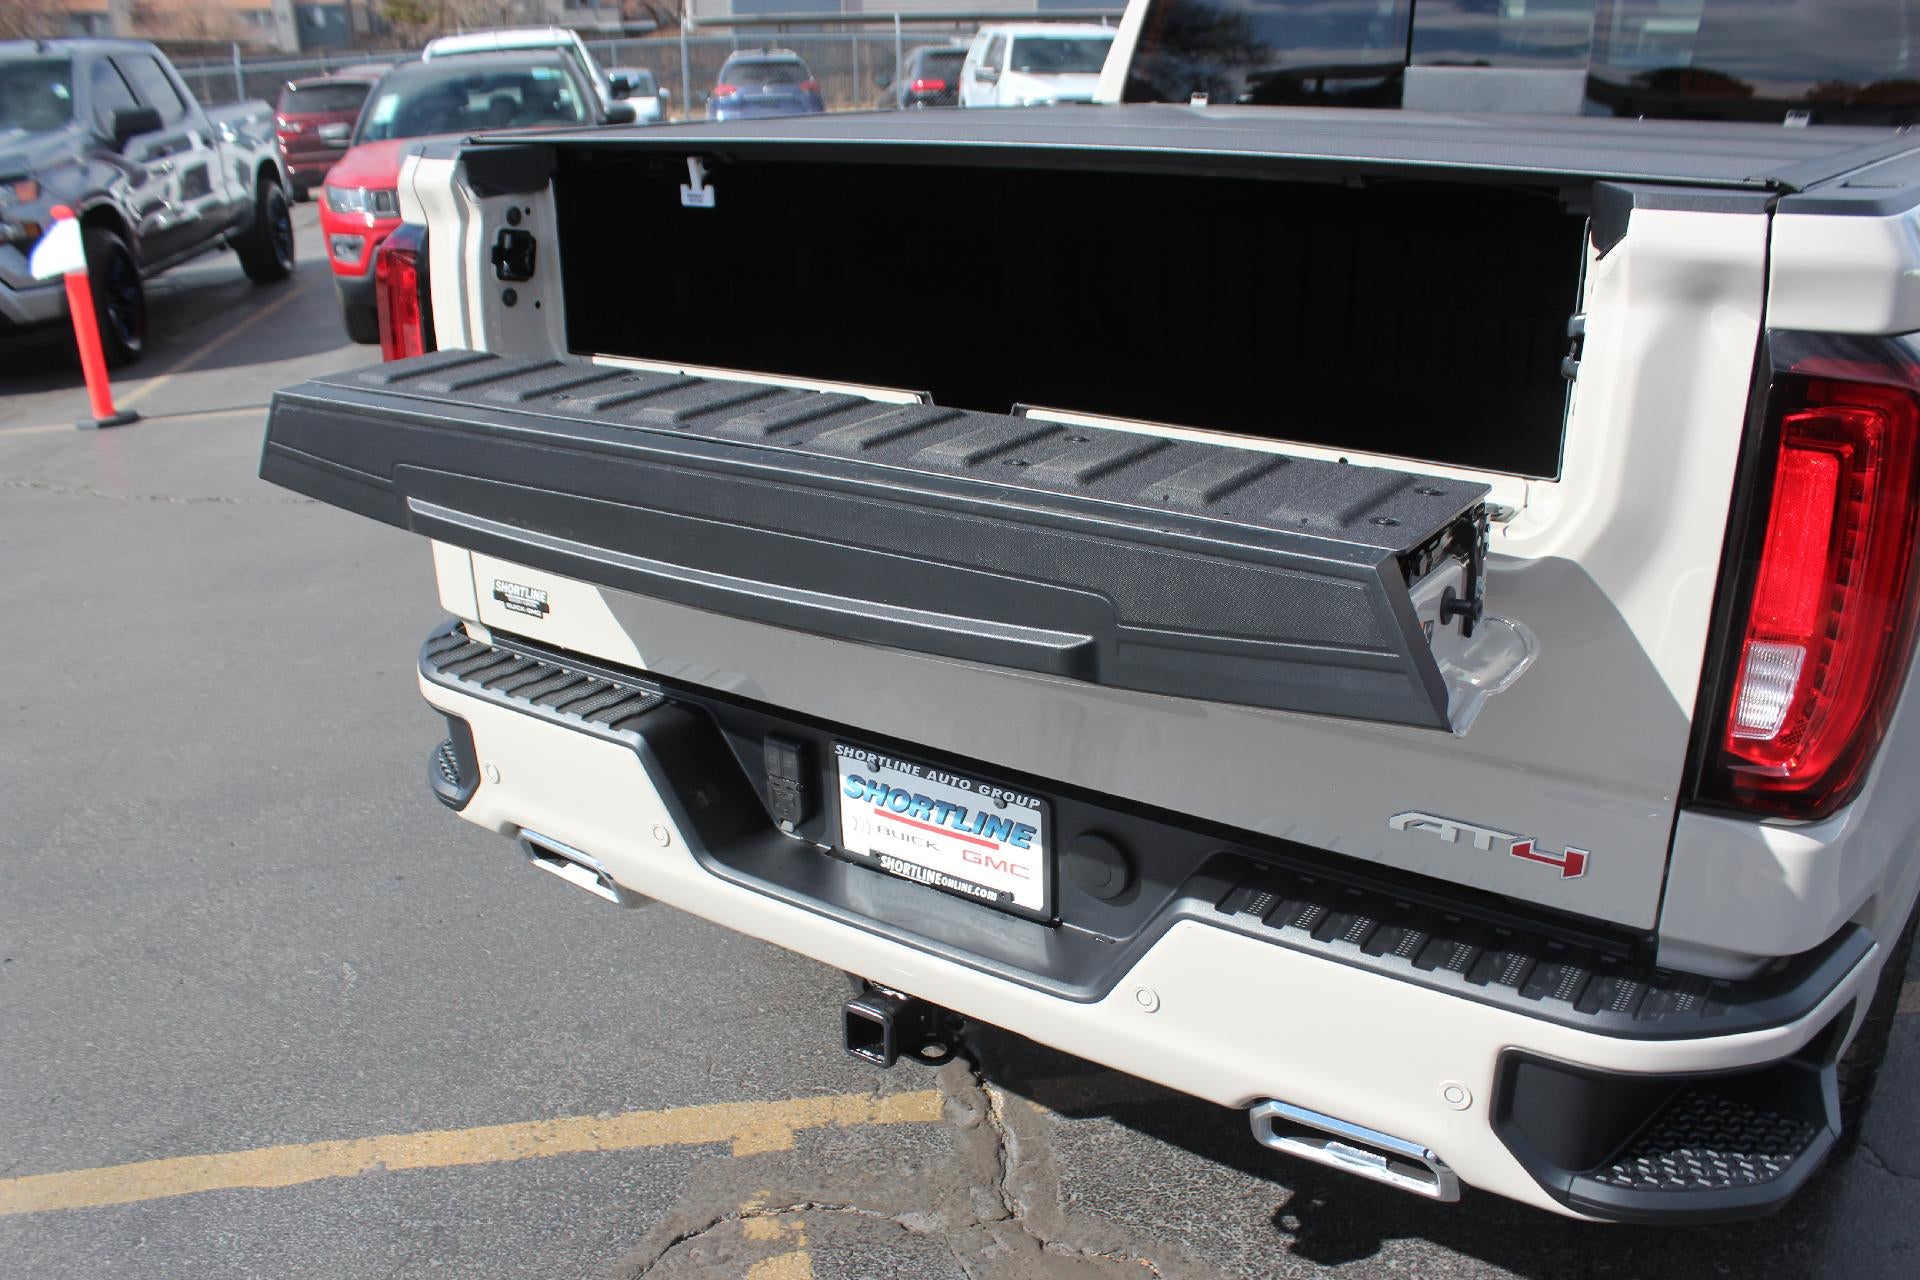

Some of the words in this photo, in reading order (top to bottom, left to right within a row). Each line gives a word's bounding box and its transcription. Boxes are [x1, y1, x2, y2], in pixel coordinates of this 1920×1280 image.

[495, 580, 547, 602] SHORTLINE
[835, 744, 921, 777] SHORTLINE
[926, 770, 971, 791] AUTO
[978, 783, 1041, 809] GROUP
[843, 773, 1038, 850] SHORTLINE
[1389, 809, 1590, 879] AT4
[877, 825, 941, 852] BUICK
[962, 849, 1030, 880] GMC
